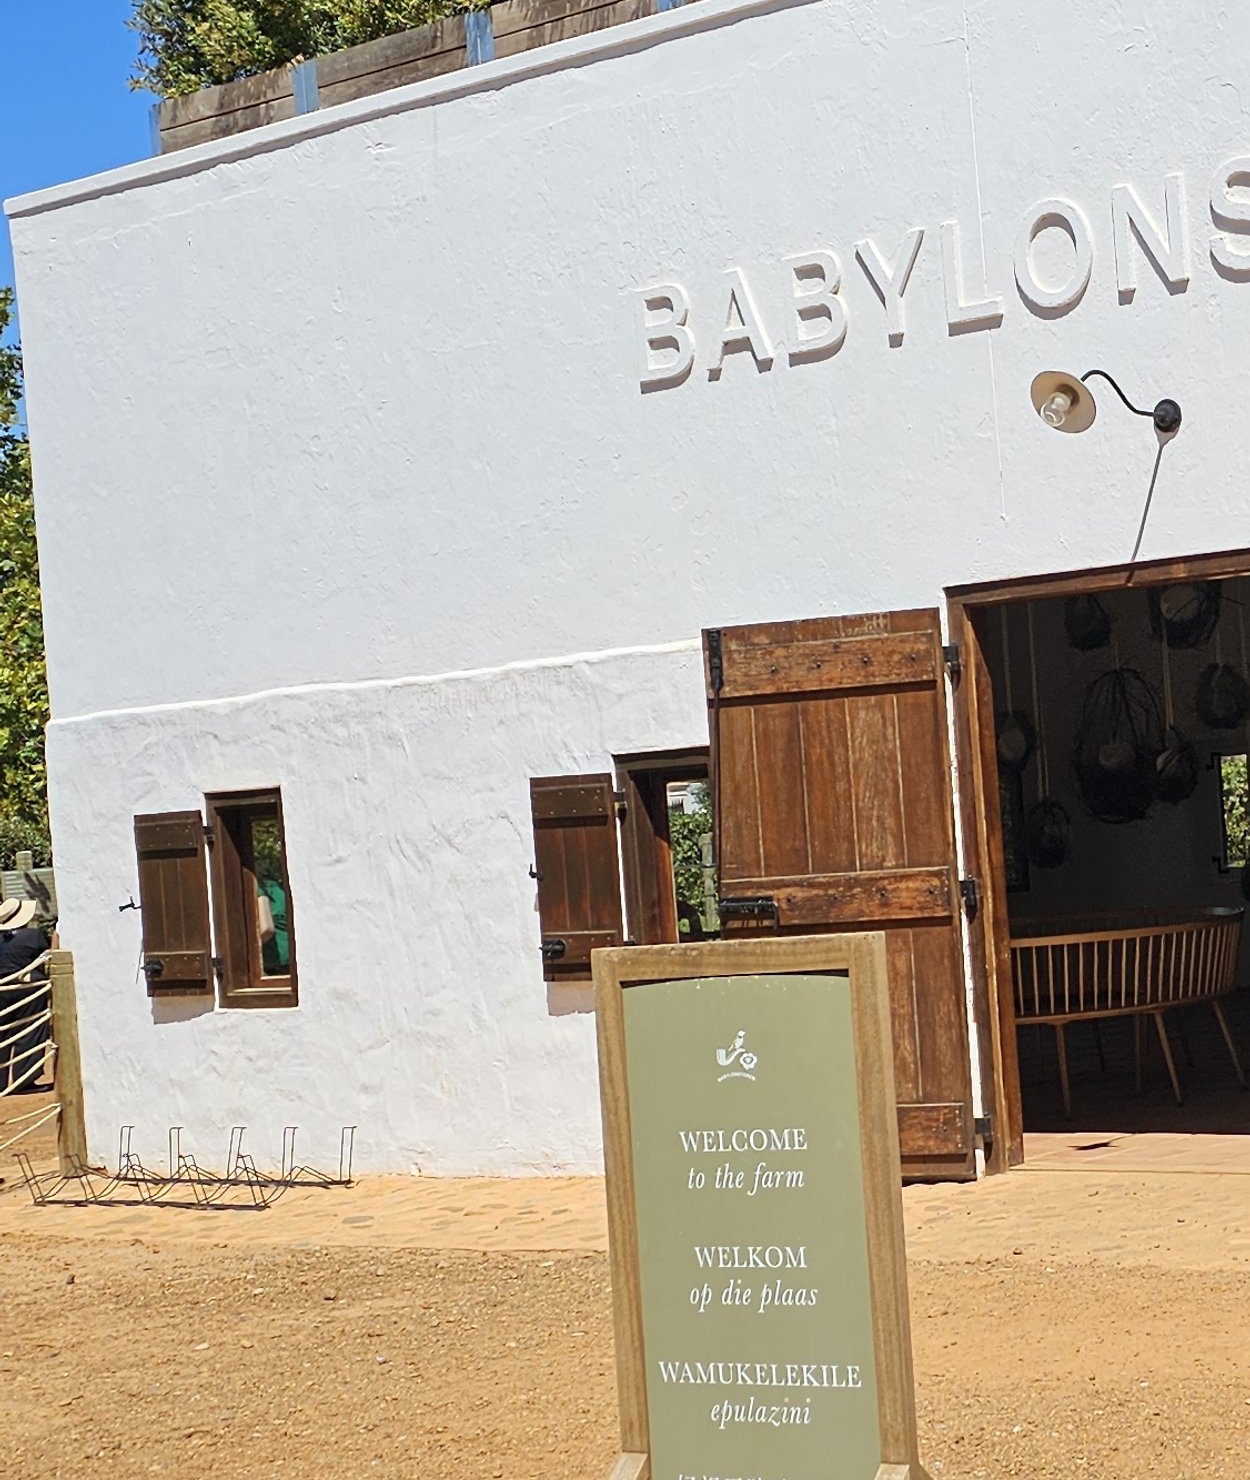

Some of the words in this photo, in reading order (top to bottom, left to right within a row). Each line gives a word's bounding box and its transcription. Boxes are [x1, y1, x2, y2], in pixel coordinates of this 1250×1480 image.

[678, 1127, 808, 1153] WELCOME
[687, 1167, 706, 1190] to
[714, 1162, 745, 1189] the
[747, 1161, 805, 1196] farm
[693, 1245, 808, 1269] WELKOM
[689, 1282, 713, 1313] op
[721, 1278, 752, 1306] die
[757, 1279, 819, 1314] plaas
[658, 1360, 862, 1388] WAMUKELEKILE
[710, 1395, 812, 1430] epulazini
